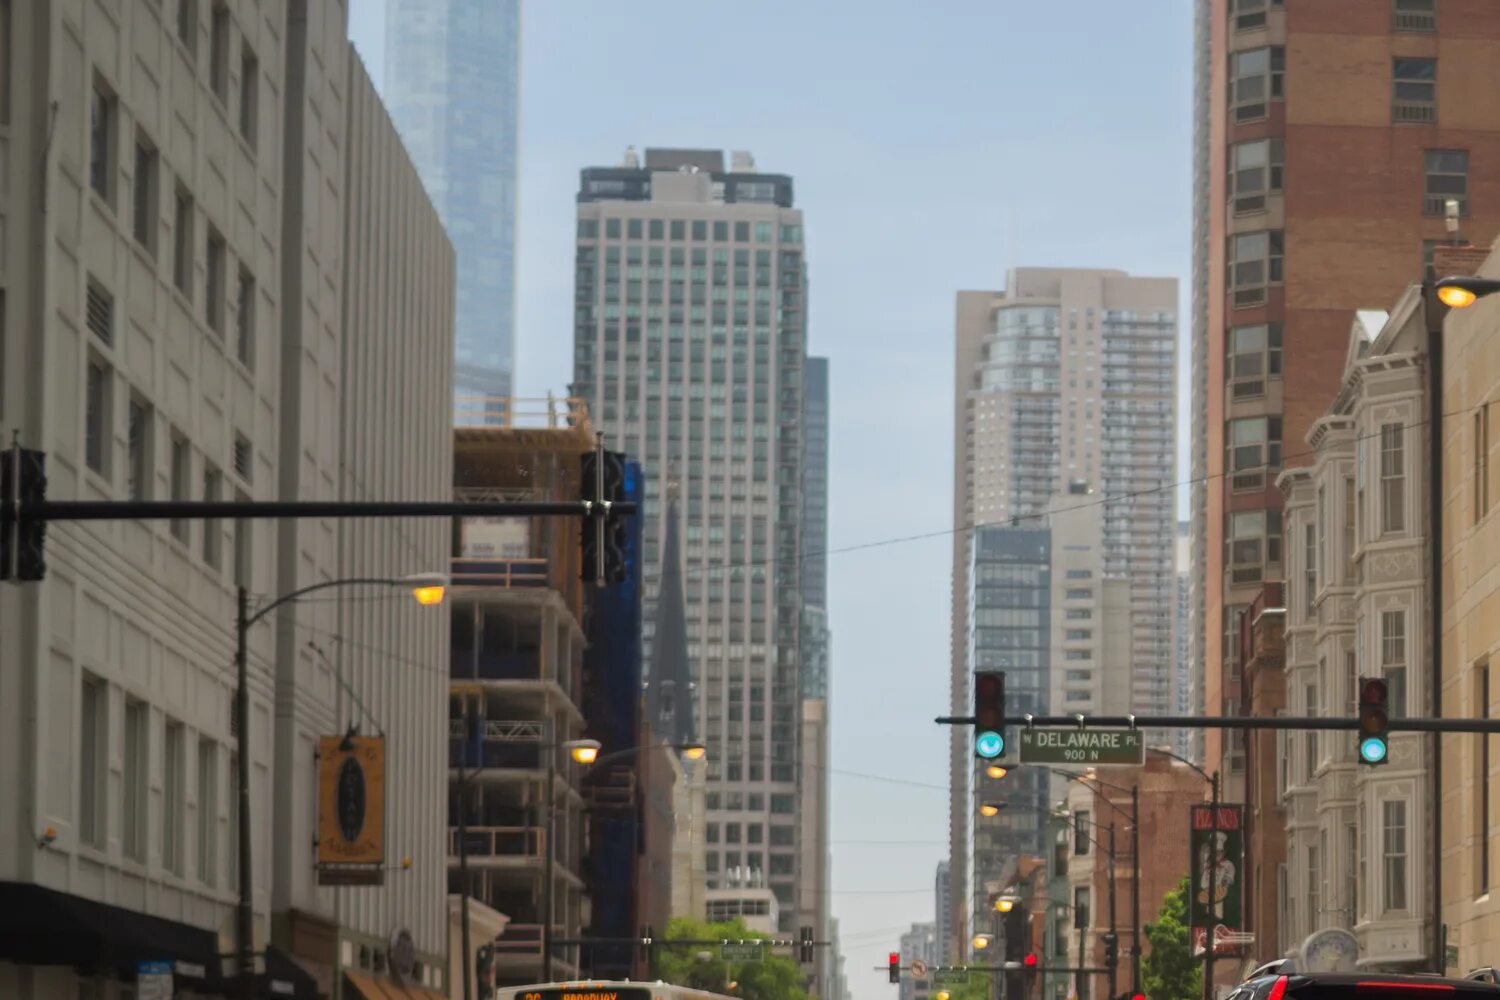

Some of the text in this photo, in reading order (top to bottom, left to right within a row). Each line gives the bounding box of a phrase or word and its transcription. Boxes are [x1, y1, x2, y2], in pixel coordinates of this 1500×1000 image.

[1023, 732, 1140, 748] W DELAWARE PL
[1064, 749, 1100, 761] 900 N
